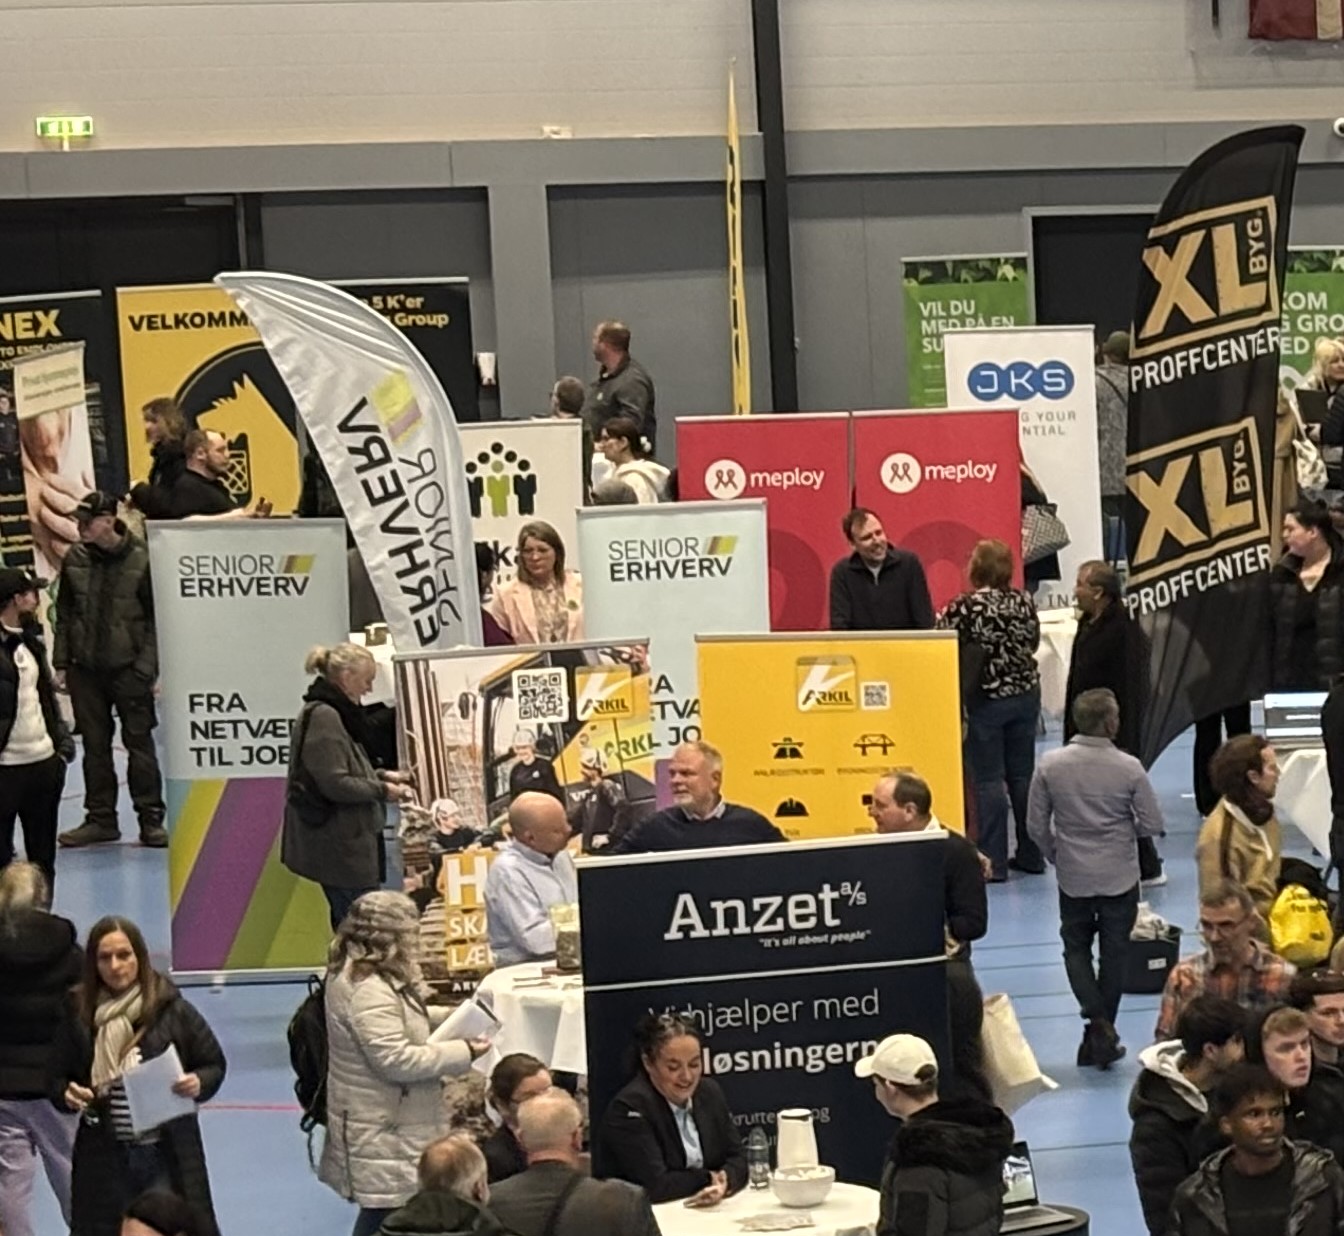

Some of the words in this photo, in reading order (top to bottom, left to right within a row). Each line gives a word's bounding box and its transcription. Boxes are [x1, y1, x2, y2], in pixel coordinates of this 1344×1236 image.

[1138, 222, 1268, 340] XL
[372, 297, 384, 310] 5
[919, 301, 949, 318] VIL
[950, 300, 976, 317] DU
[404, 312, 450, 328] Group
[1131, 326, 1282, 394] PROFFCENTER
[976, 369, 1068, 393] JKS
[1037, 410, 1077, 423] YOUR
[750, 467, 825, 491] meploy
[925, 460, 998, 484] meploy
[1125, 446, 1255, 567] XL
[608, 536, 700, 561] SENIOR
[177, 554, 275, 576] SENIOR
[609, 557, 734, 582] ERHVERV
[180, 576, 310, 598] ERHVERV
[1127, 545, 1272, 621] PROFFCENTER
[189, 692, 248, 714] FRA
[581, 697, 629, 715] ARKIL
[803, 688, 854, 706] ARKIL
[190, 718, 296, 741] NETVÆ
[189, 746, 234, 768] TIL
[664, 882, 842, 941] Anzet
[798, 933, 829, 947] about
[813, 988, 880, 1021] med
